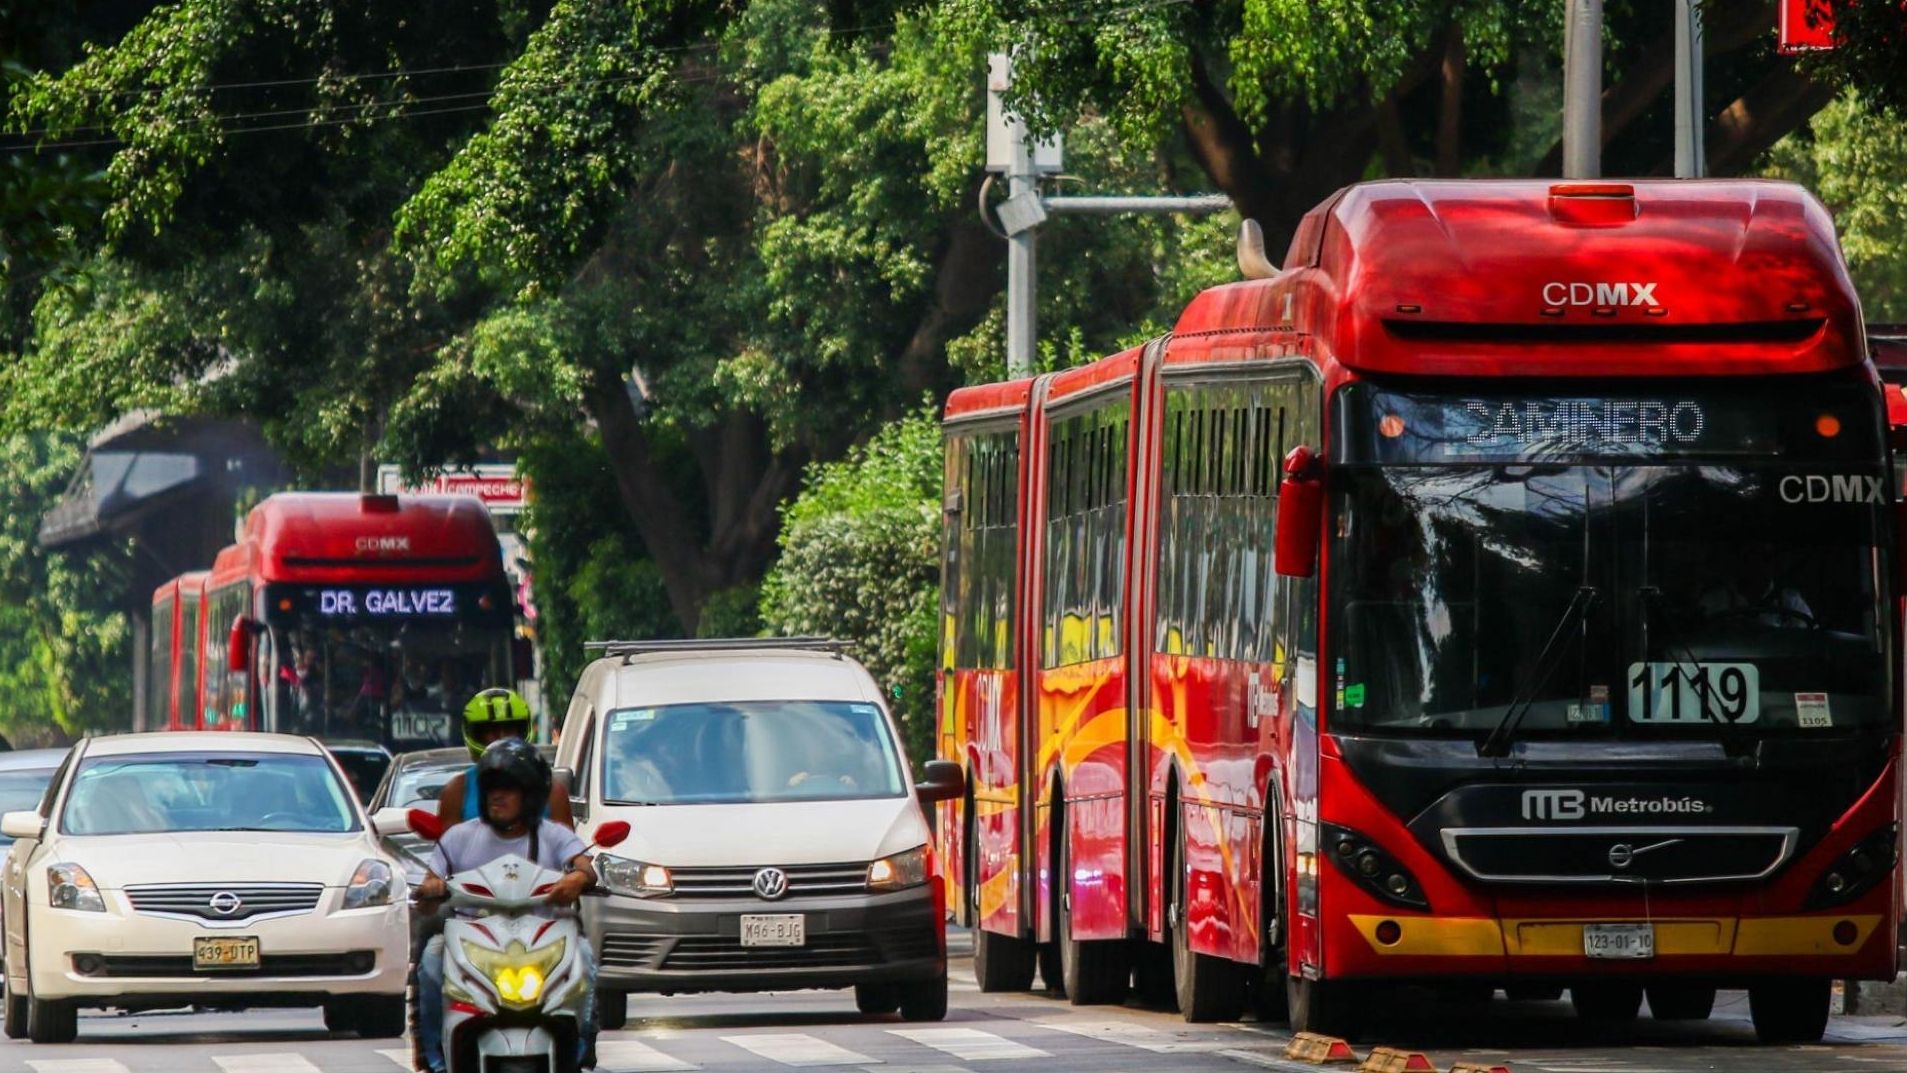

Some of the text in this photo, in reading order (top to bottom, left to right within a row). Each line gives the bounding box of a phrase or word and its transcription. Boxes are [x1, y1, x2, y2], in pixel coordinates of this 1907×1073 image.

[1543, 282, 1660, 306] CDMX
[1780, 475, 1885, 504] CDMX
[355, 536, 410, 551] CDMX
[321, 590, 453, 613] DR. GALVEZ
[1632, 667, 1748, 721] 1119
[1589, 934, 1652, 949] 123-01-10
